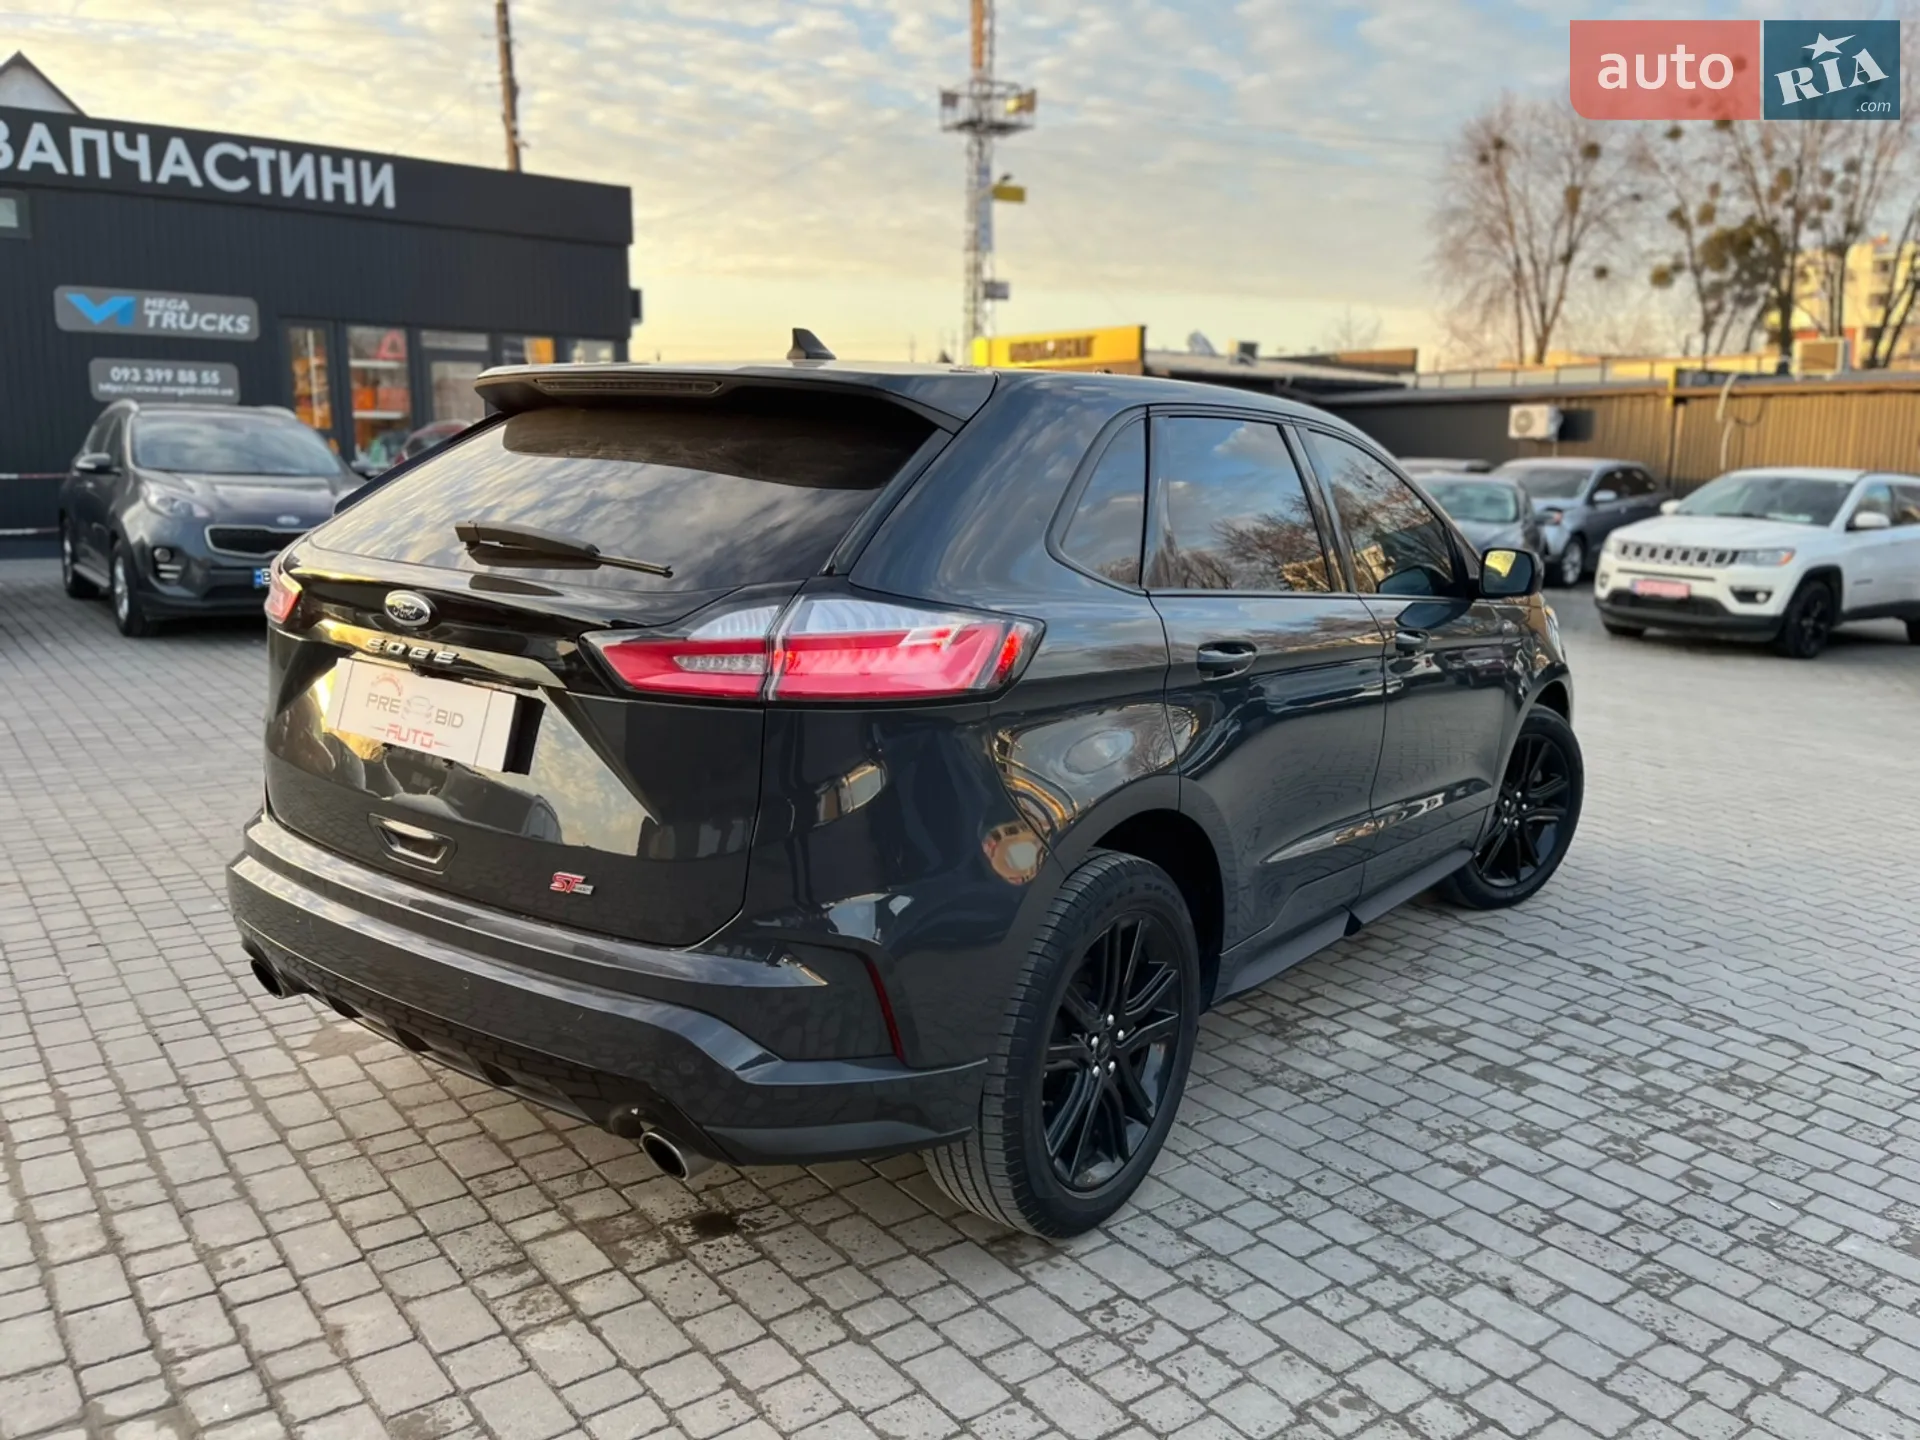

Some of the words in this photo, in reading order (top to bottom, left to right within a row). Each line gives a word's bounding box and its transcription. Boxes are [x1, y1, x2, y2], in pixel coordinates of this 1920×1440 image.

[143, 297, 190, 312] MEGA
[144, 310, 250, 334] TRUCKS
[110, 367, 140, 382] 093
[144, 368, 173, 383] 399
[365, 637, 458, 664] EDGE
[366, 694, 401, 714] PRE
[434, 709, 464, 729] BID
[385, 724, 434, 748] AUTO
[549, 871, 586, 893] ST
